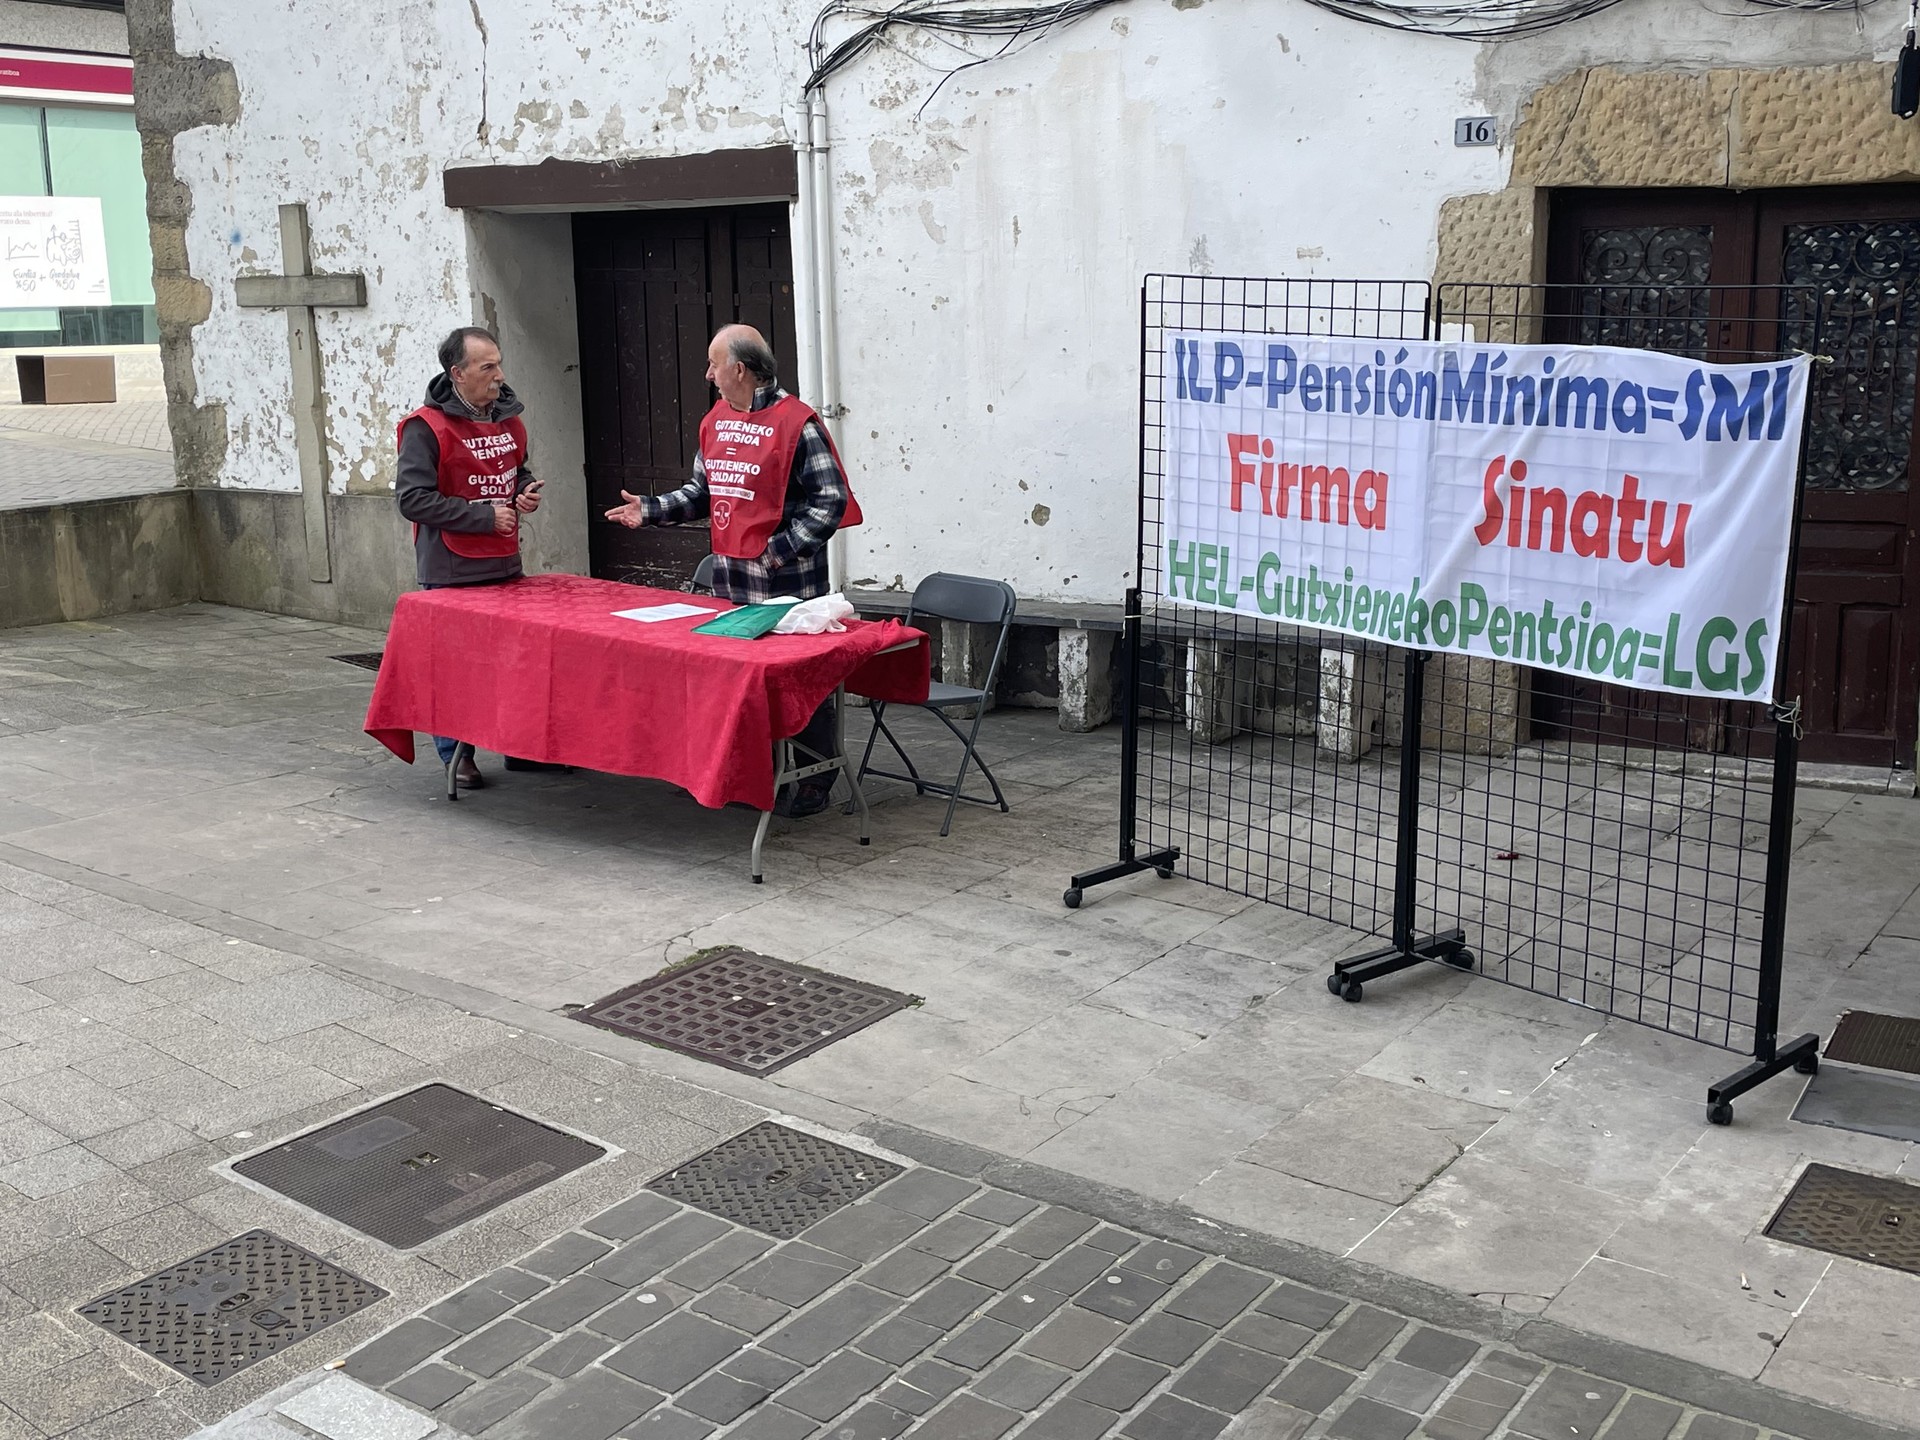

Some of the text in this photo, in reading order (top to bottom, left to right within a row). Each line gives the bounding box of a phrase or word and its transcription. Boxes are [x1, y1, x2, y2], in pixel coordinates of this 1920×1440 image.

[1464, 120, 1490, 142] 16
[717, 431, 760, 447] PENTSIOA
[705, 459, 761, 476] GUTXIENEKO
[710, 471, 745, 485] SOLDATA
[1228, 433, 1389, 530] Firma
[1473, 454, 1692, 569] Sinatu
